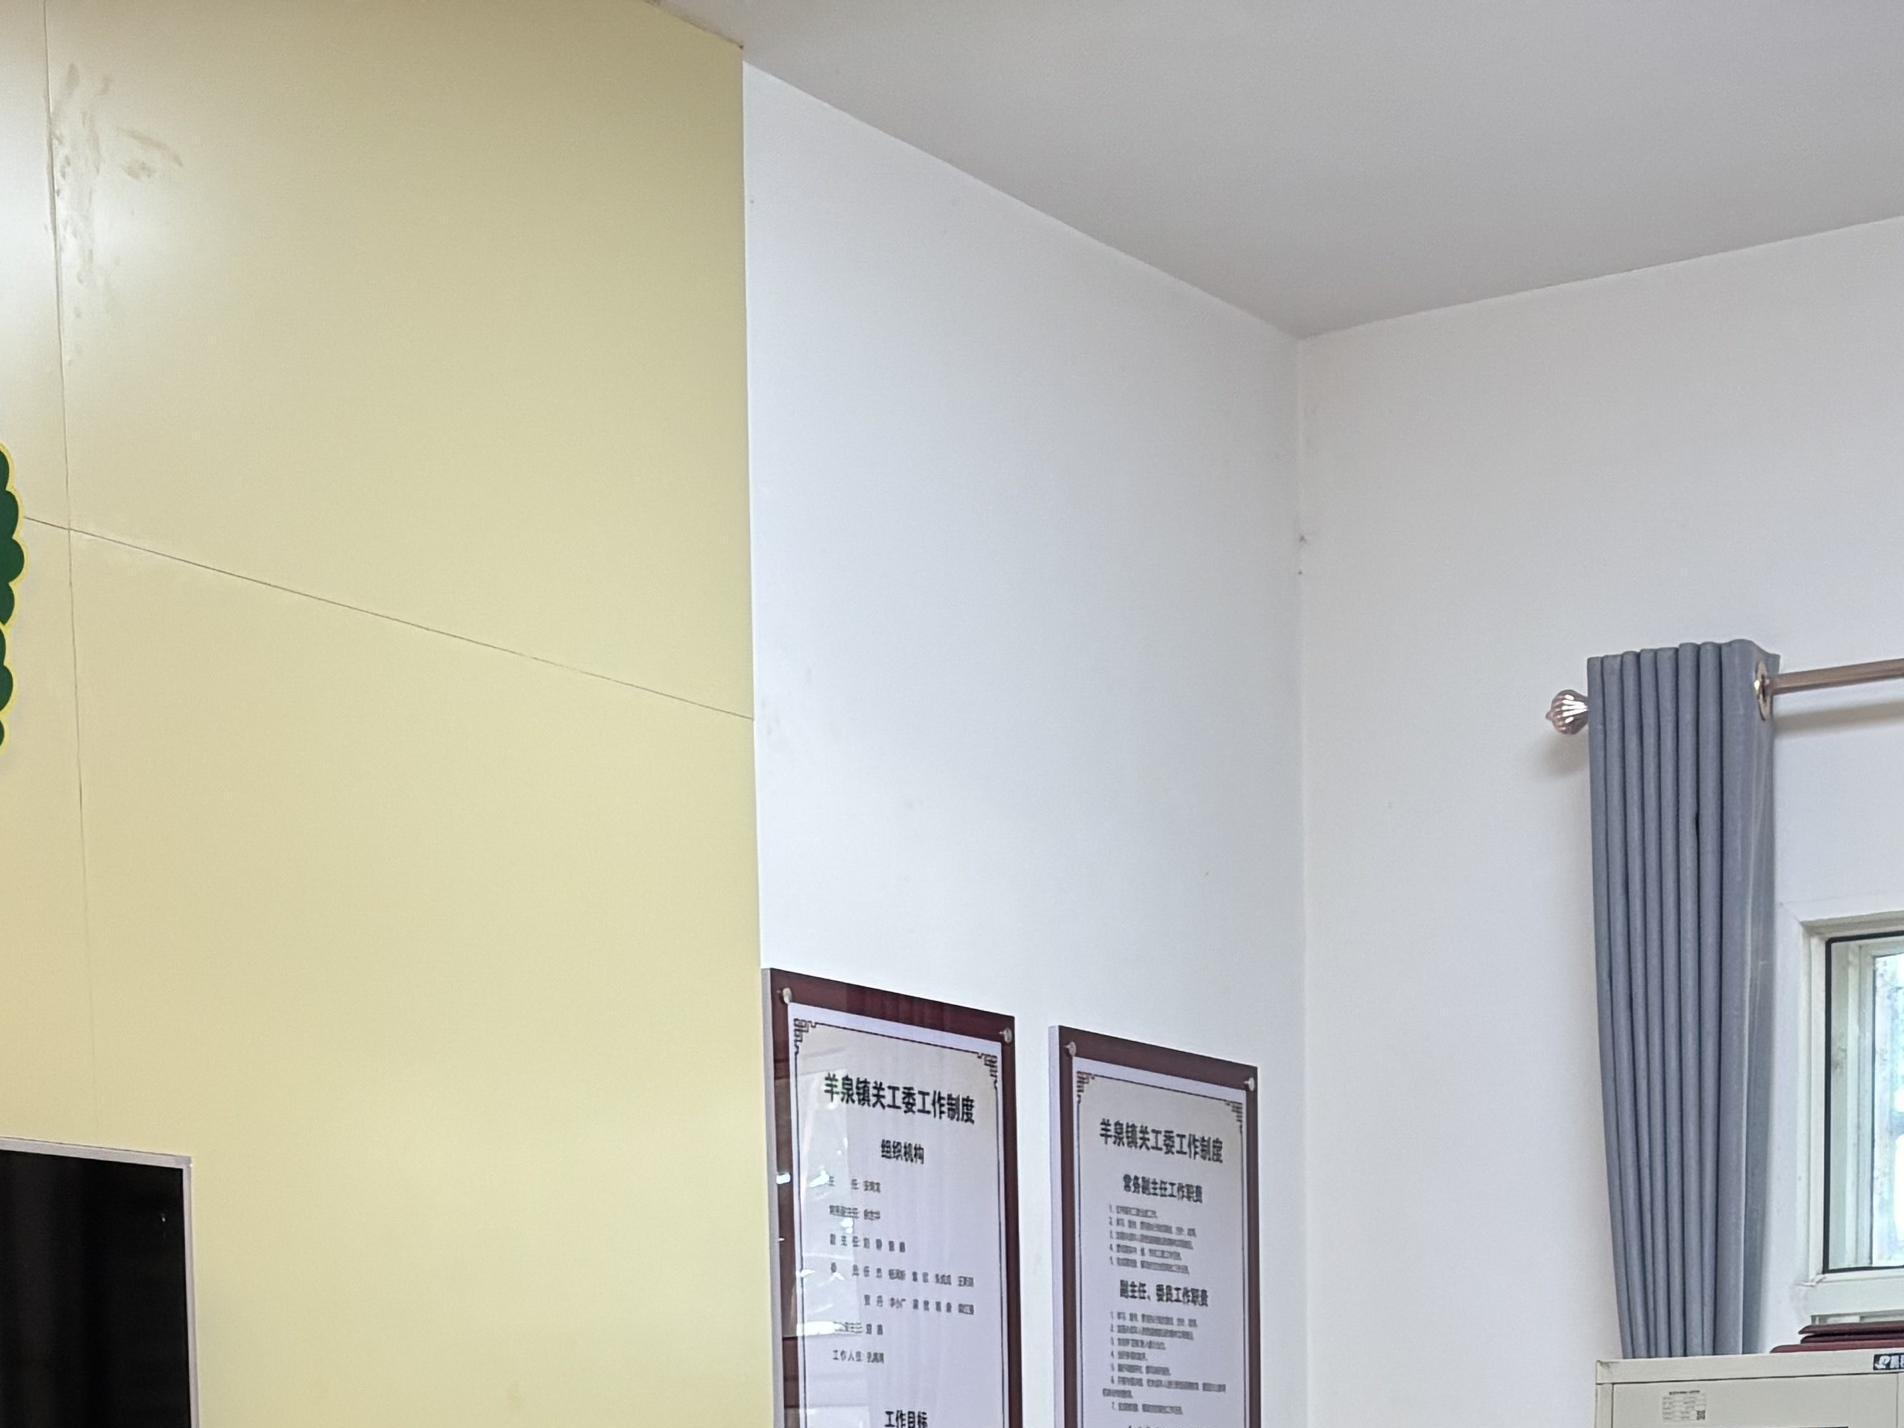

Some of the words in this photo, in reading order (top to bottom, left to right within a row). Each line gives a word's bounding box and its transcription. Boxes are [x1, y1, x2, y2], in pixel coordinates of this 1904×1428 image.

[824, 1071, 976, 1125] 羊泉镇关工委工作制度
[880, 1138, 926, 1165] 组织机构
[1099, 1117, 1224, 1164] 羊泉镇关工委工作制度
